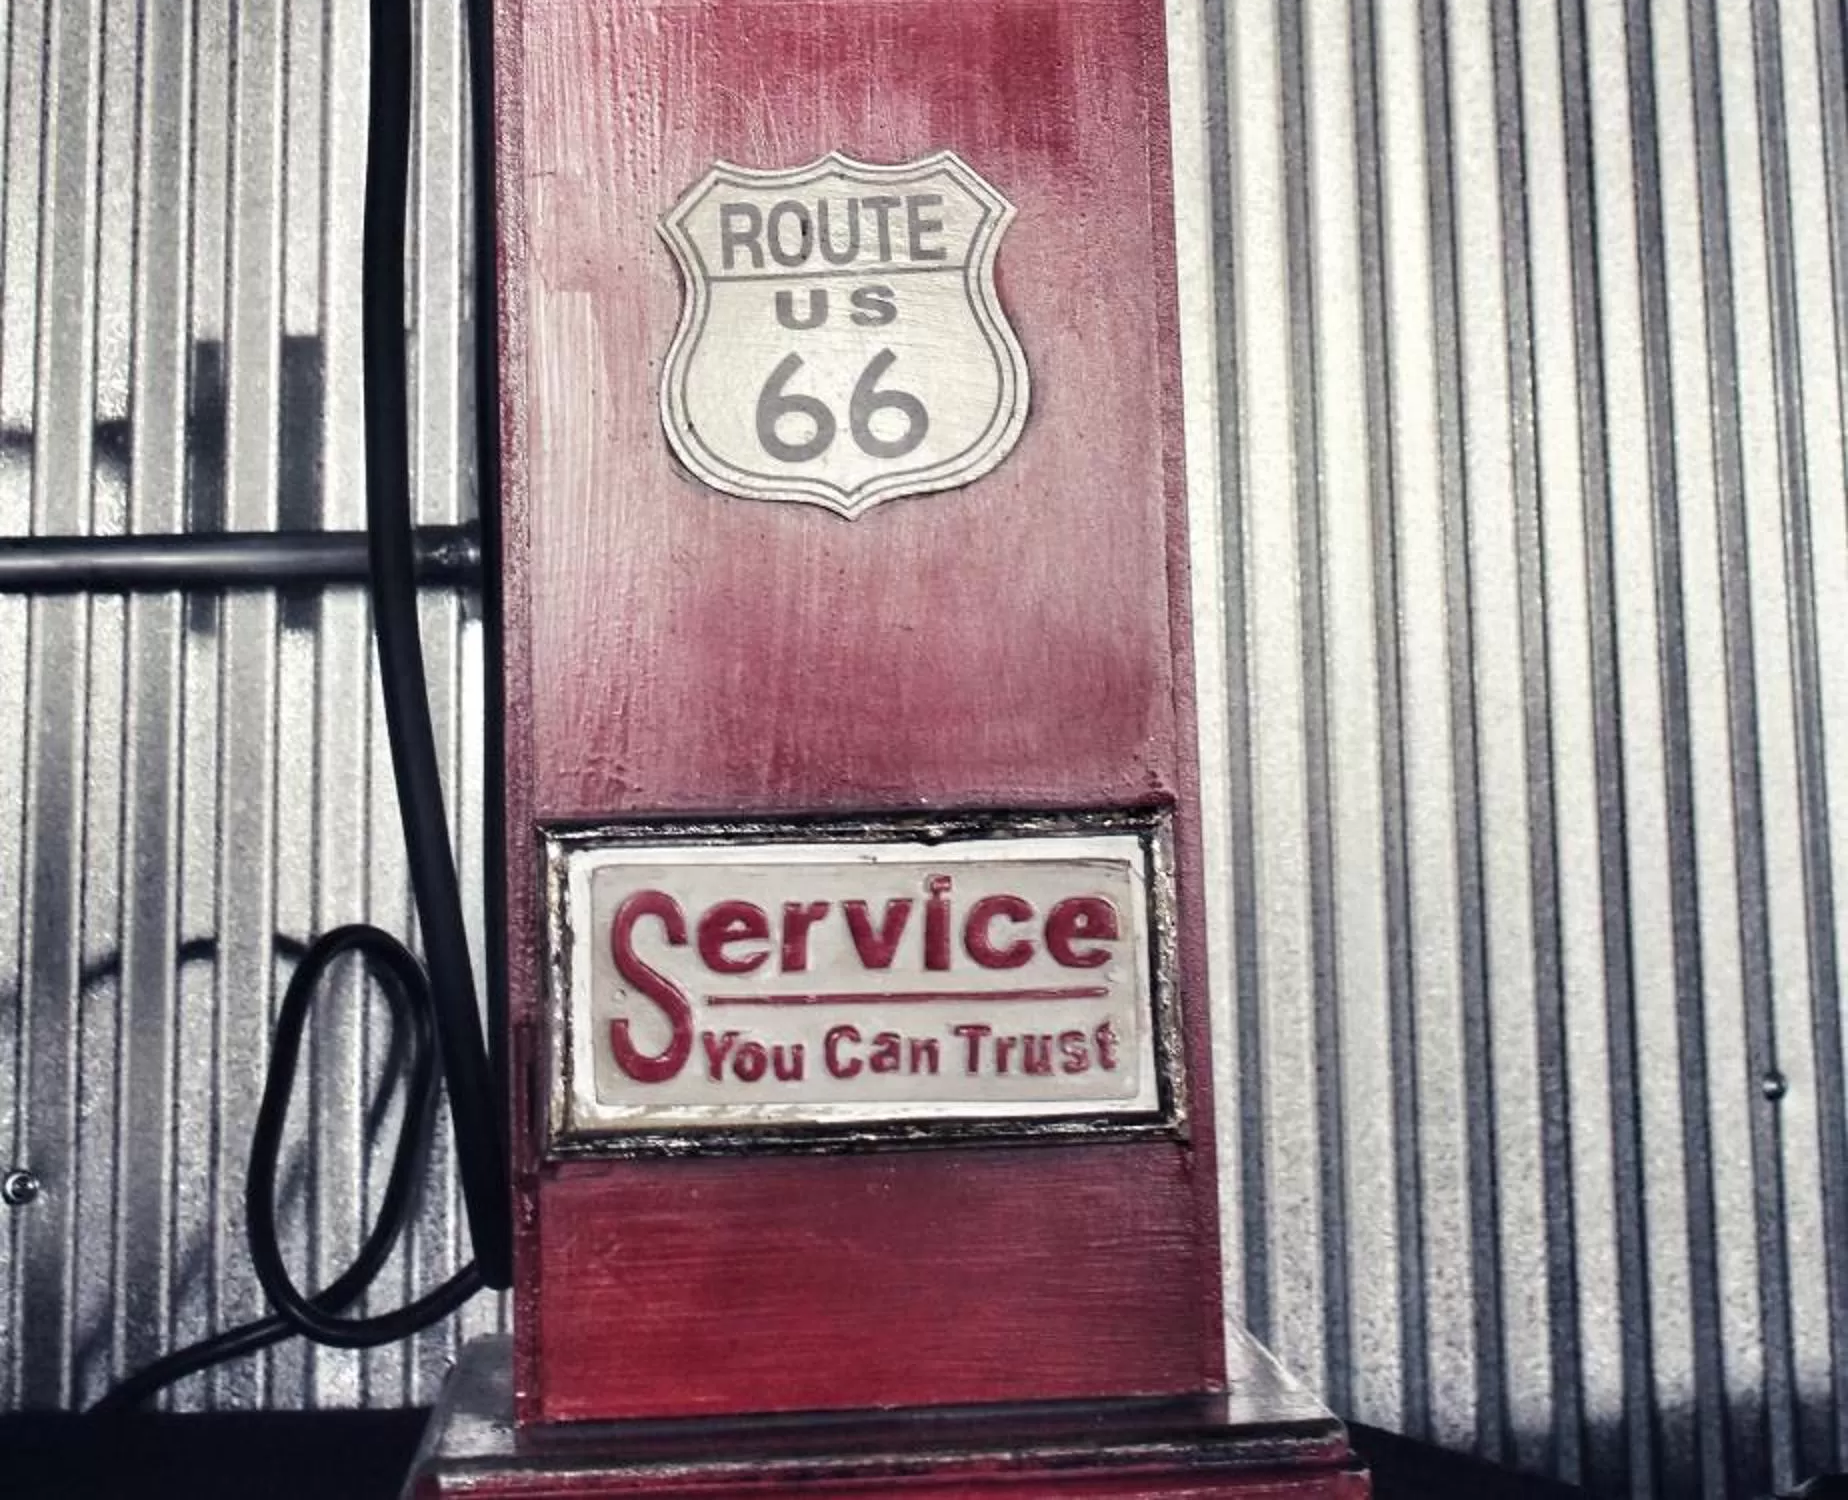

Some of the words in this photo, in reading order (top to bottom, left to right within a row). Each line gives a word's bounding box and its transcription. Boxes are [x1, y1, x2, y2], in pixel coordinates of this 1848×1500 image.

[719, 194, 948, 271] ROUTE
[774, 284, 899, 331] US
[755, 346, 930, 463] 66
[610, 873, 1121, 1084] Service
[702, 1029, 806, 1083] You
[823, 1023, 941, 1077] Can
[953, 1018, 1118, 1077] Trust
